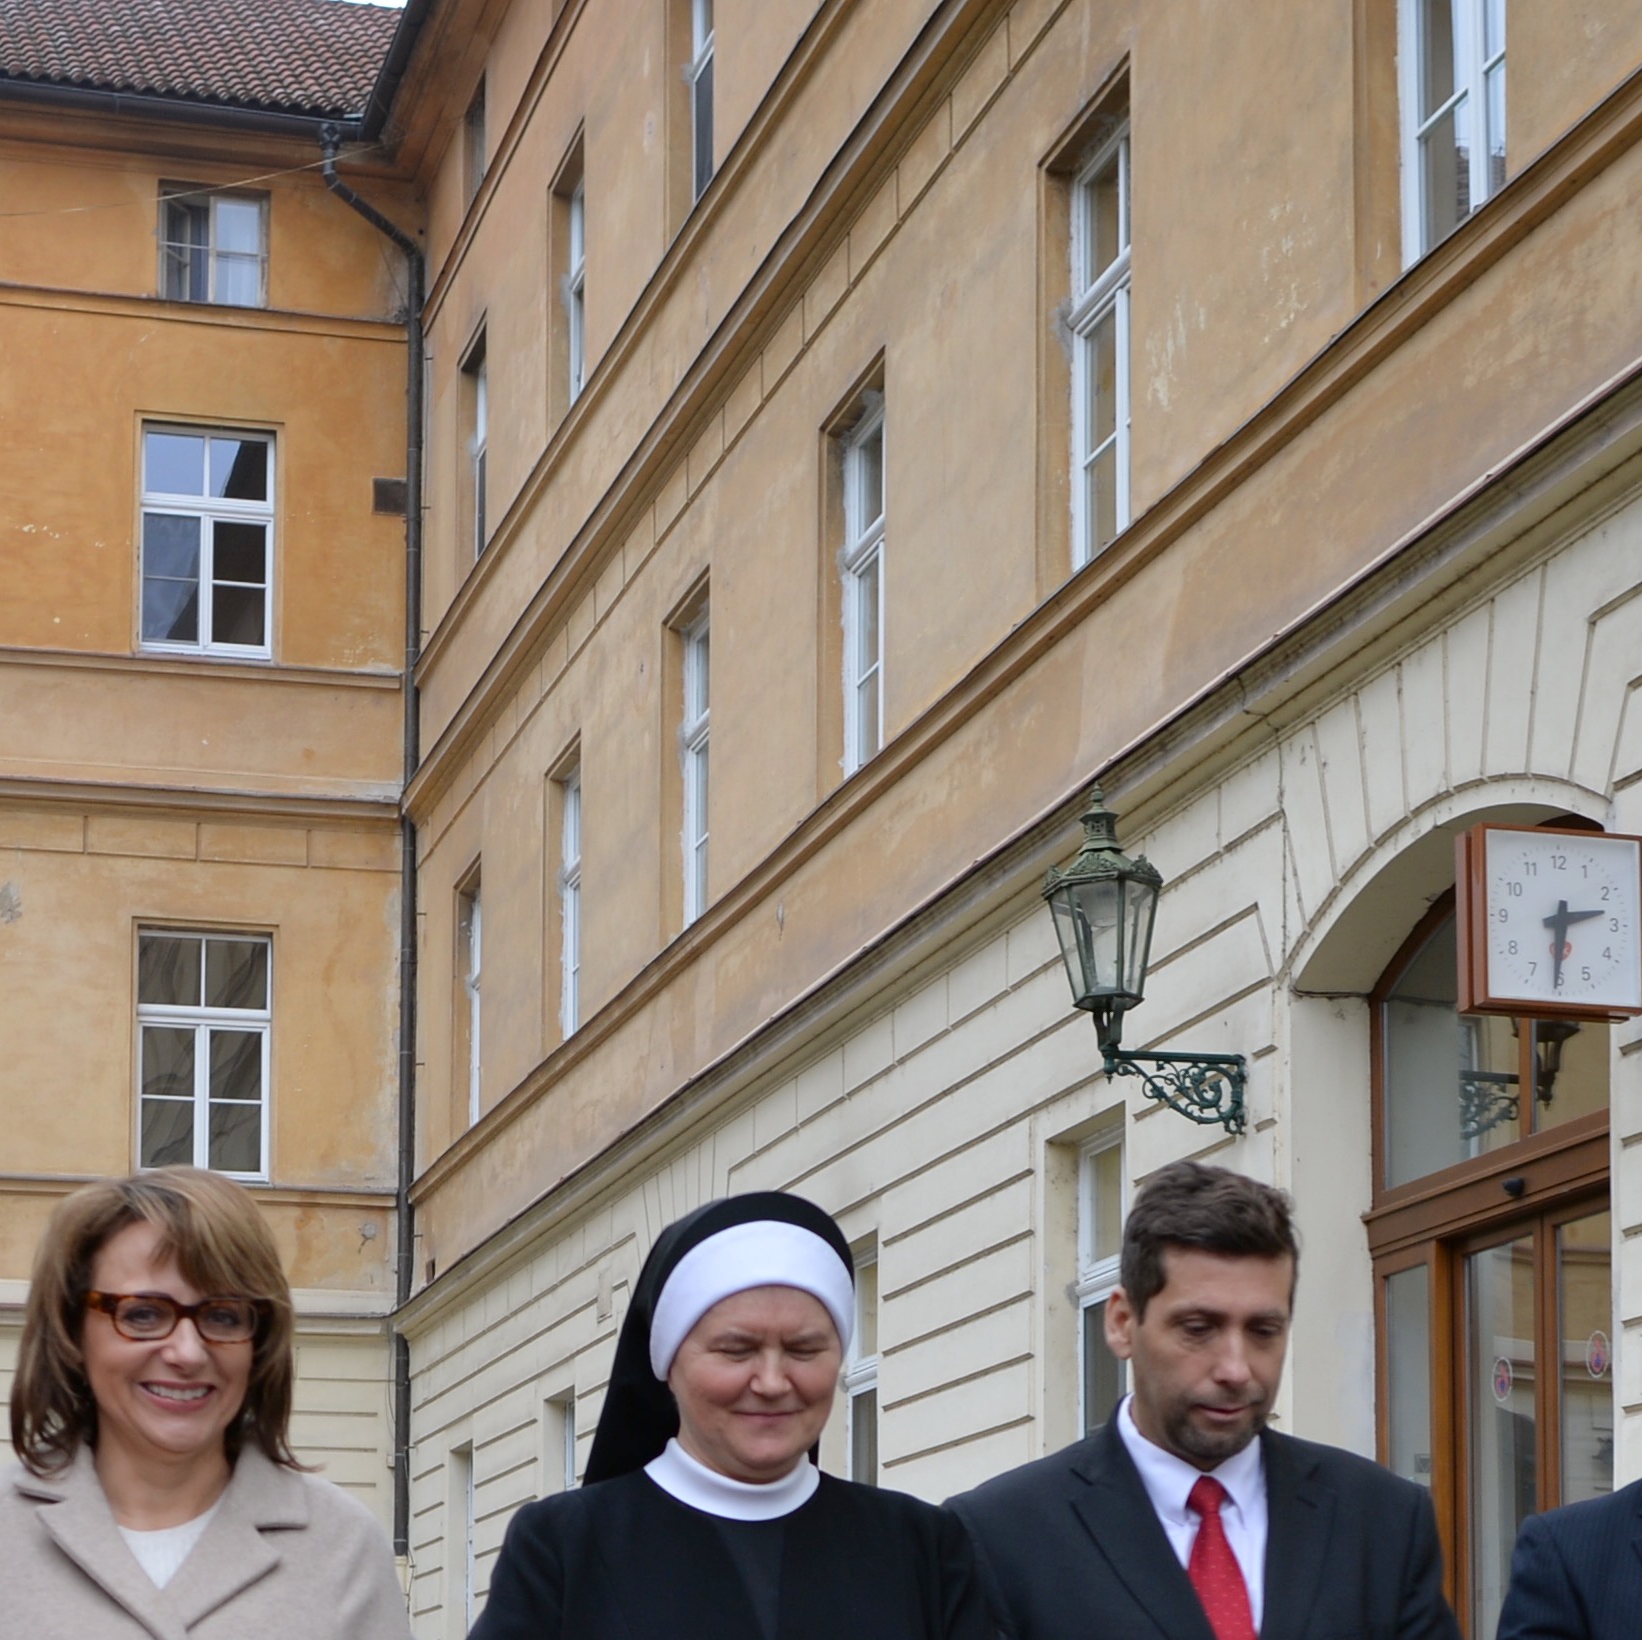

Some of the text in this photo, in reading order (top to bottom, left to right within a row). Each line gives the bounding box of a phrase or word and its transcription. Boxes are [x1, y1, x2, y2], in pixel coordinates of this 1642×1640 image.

[1523, 861, 1538, 876] 11
[1550, 855, 1567, 871] 12
[1581, 864, 1588, 878] 1
[1506, 881, 1523, 898] 10
[1600, 886, 1610, 901] 2
[1498, 908, 1508, 924] 9
[1609, 918, 1619, 933] 3
[1508, 939, 1518, 955] 8
[1601, 946, 1612, 961] 4
[1527, 961, 1537, 976] 7
[1581, 966, 1591, 981] 5
